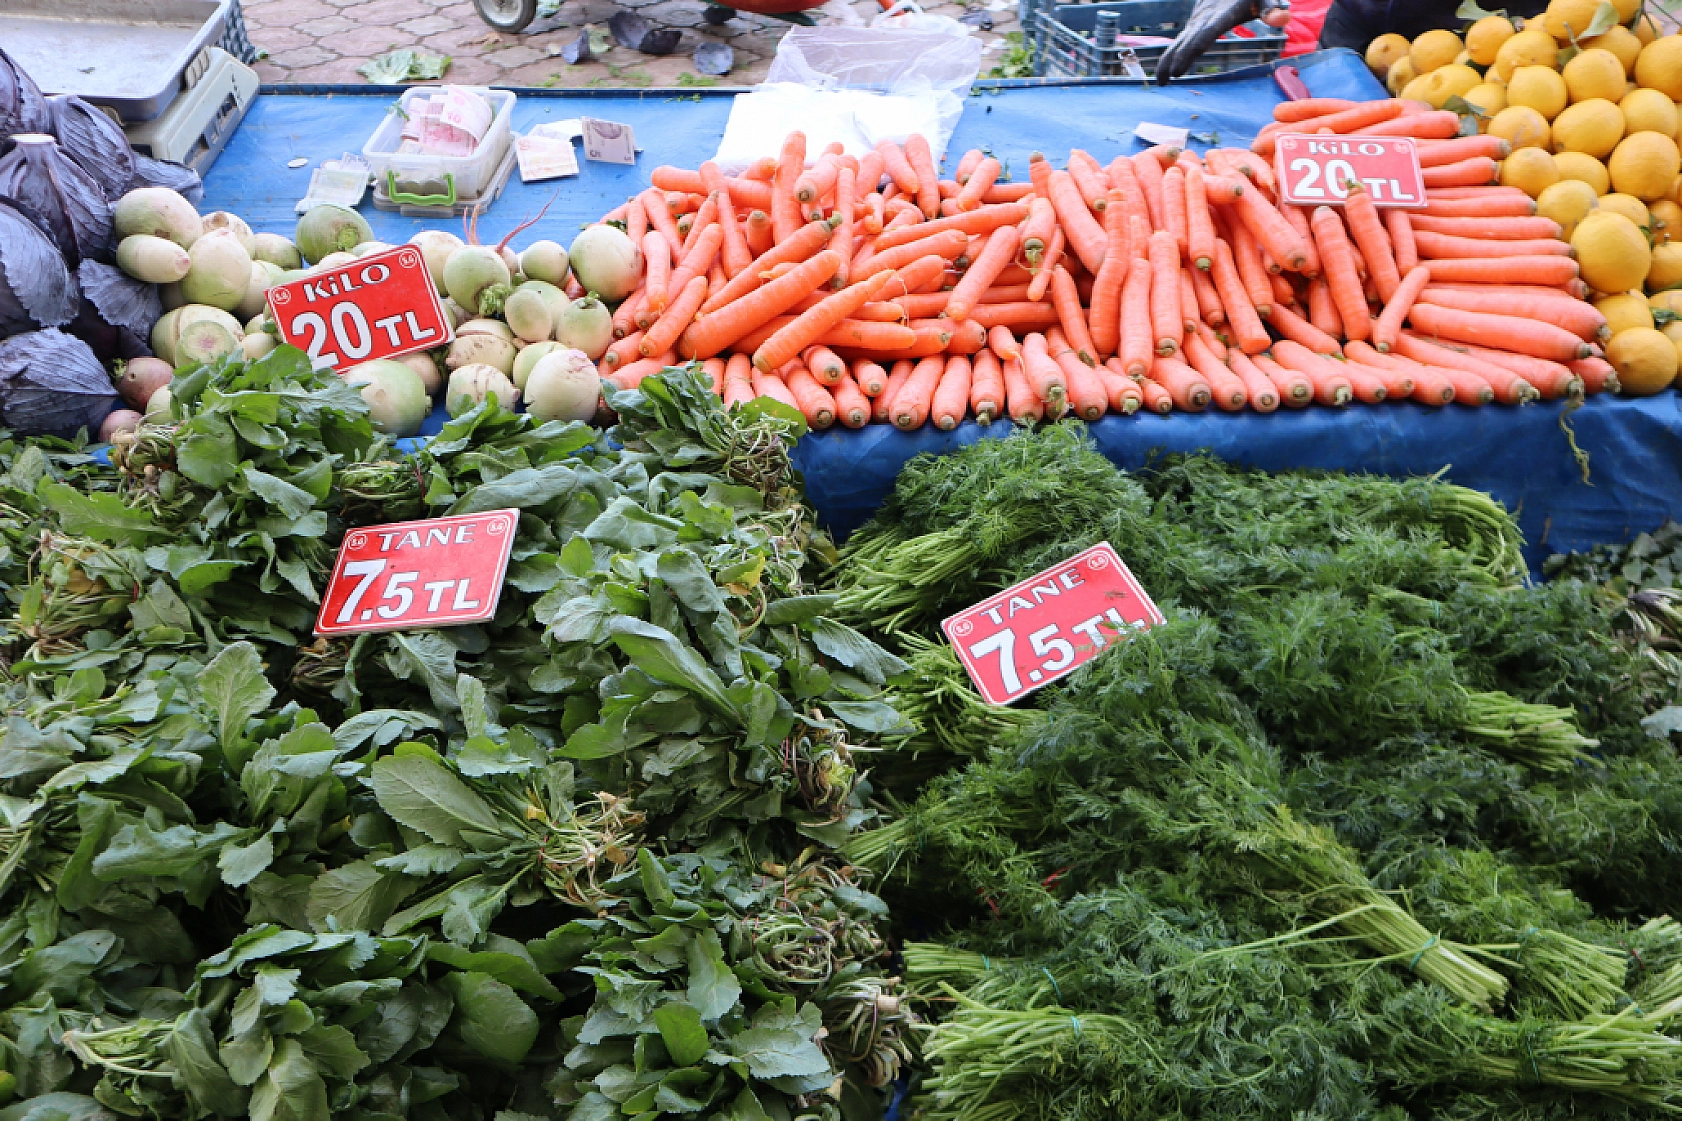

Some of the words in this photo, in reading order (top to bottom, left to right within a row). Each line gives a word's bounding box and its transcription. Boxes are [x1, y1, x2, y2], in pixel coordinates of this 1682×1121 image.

[1290, 157, 1357, 199] 20
[1361, 178, 1415, 200] TL
[303, 264, 391, 302] KiLO
[291, 301, 372, 370] 20
[374, 311, 436, 347] TL
[377, 524, 477, 552] TANE
[335, 558, 420, 624] 7.5
[424, 578, 481, 613] TL
[979, 567, 1086, 626] TANE
[968, 622, 1076, 695] 7.5
[1071, 607, 1146, 649] TL
